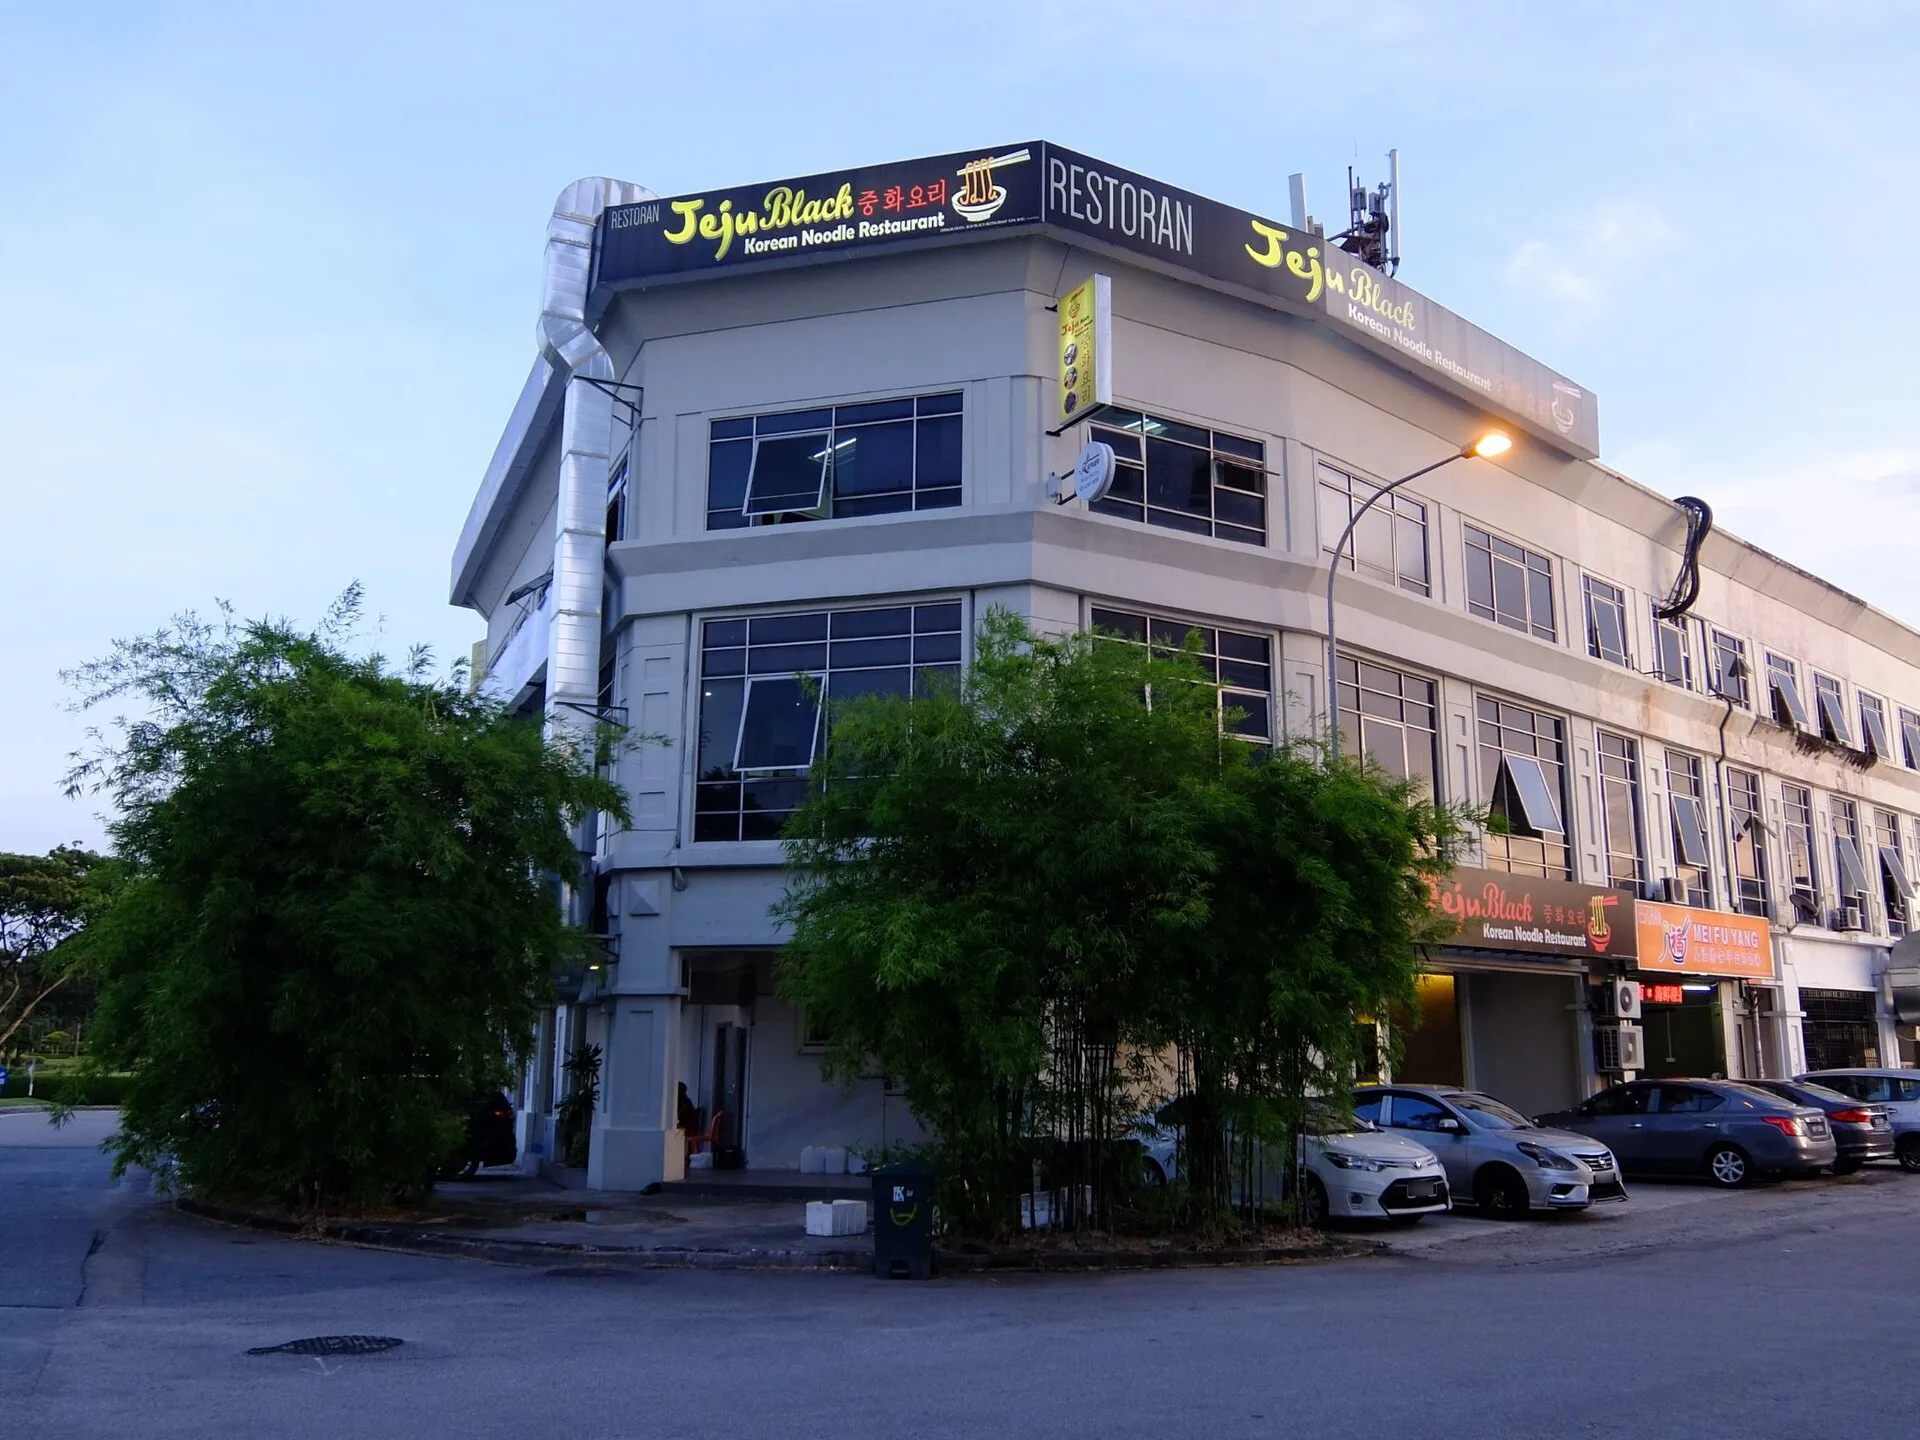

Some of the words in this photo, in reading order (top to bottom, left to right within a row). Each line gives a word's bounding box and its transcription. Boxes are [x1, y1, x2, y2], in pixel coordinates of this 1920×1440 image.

[611, 204, 660, 230] RESTORAN
[857, 178, 947, 217] 중화요리
[1050, 157, 1193, 256] RESTORAN
[663, 198, 758, 262] Jeju
[759, 181, 855, 229] Black
[744, 236, 798, 255] Korean
[801, 224, 855, 247] Noodle
[859, 212, 945, 238] Restaurant
[1244, 219, 1346, 303] Jeju
[1348, 267, 1417, 331] Black
[1348, 302, 1391, 339] Korean
[1393, 326, 1433, 361] Noodle
[1434, 349, 1493, 392] Restaurant
[1481, 881, 1534, 923] Black
[1483, 922, 1514, 941] Korean
[1515, 925, 1544, 943] Noodle
[1544, 928, 1587, 948] Restaurant
[1731, 928, 1759, 948] YANG
